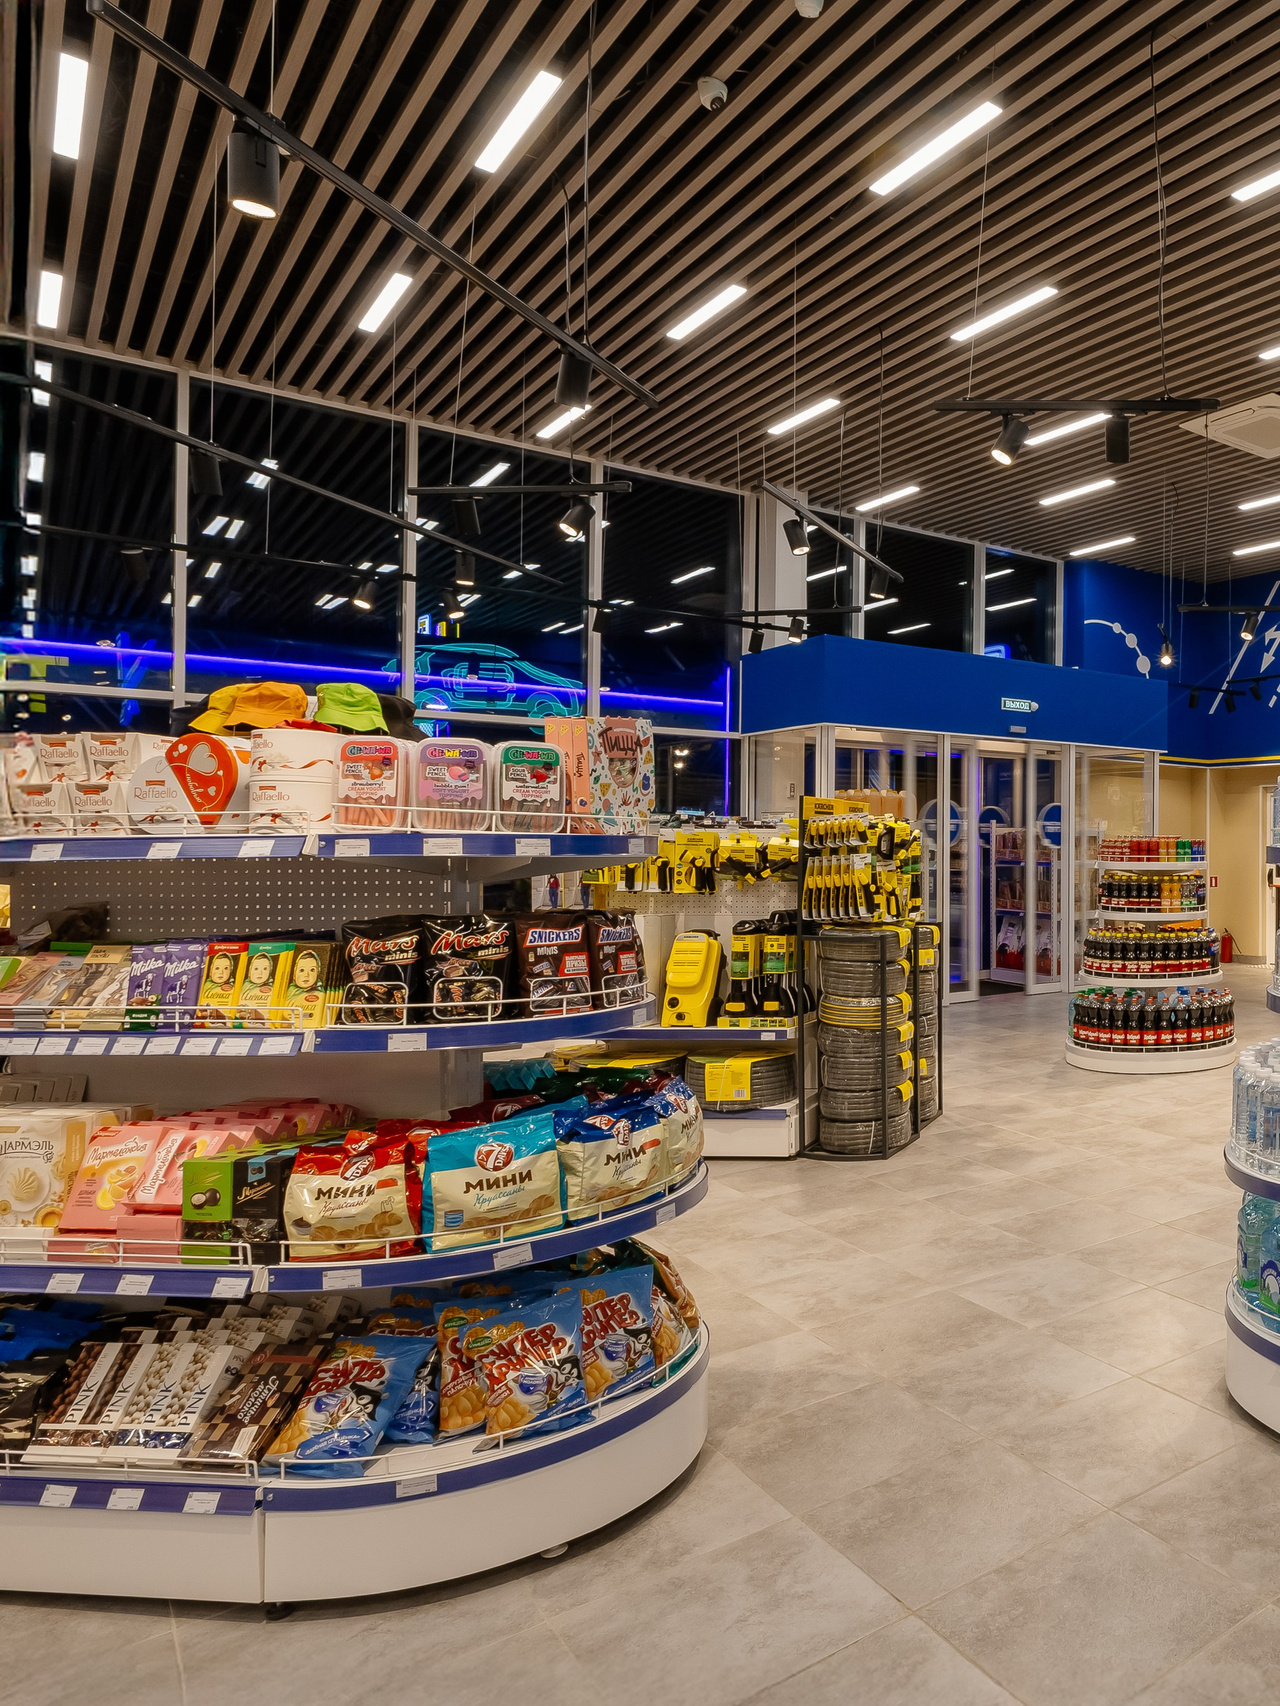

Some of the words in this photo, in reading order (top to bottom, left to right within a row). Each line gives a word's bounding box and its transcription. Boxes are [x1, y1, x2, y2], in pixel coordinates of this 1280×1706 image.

[1005, 700, 1030, 710] ВЫХОД
[40, 748, 79, 759] Raffaello
[90, 746, 129, 757] Raffaello
[134, 787, 178, 799] Raffaello
[252, 791, 290, 801] Raffaello
[75, 796, 113, 807] Raffaello
[431, 930, 509, 955] Mars
[529, 928, 581, 944] SNICKERS
[600, 927, 633, 942] SNICKERS
[346, 935, 420, 957] Mars
[477, 945, 509, 957] minis
[537, 946, 558, 955] MINIS
[384, 951, 418, 961] minis
[130, 957, 165, 977] Milka
[164, 957, 200, 978] Milka
[463, 1170, 533, 1194] МИНИ
[315, 1184, 376, 1200] МИНИ
[581, 1293, 631, 1328] УПЕР
[64, 1380, 99, 1425] PINK
[100, 1381, 135, 1426] PINK
[143, 1380, 178, 1425] PINK
[178, 1382, 212, 1427] PINK
